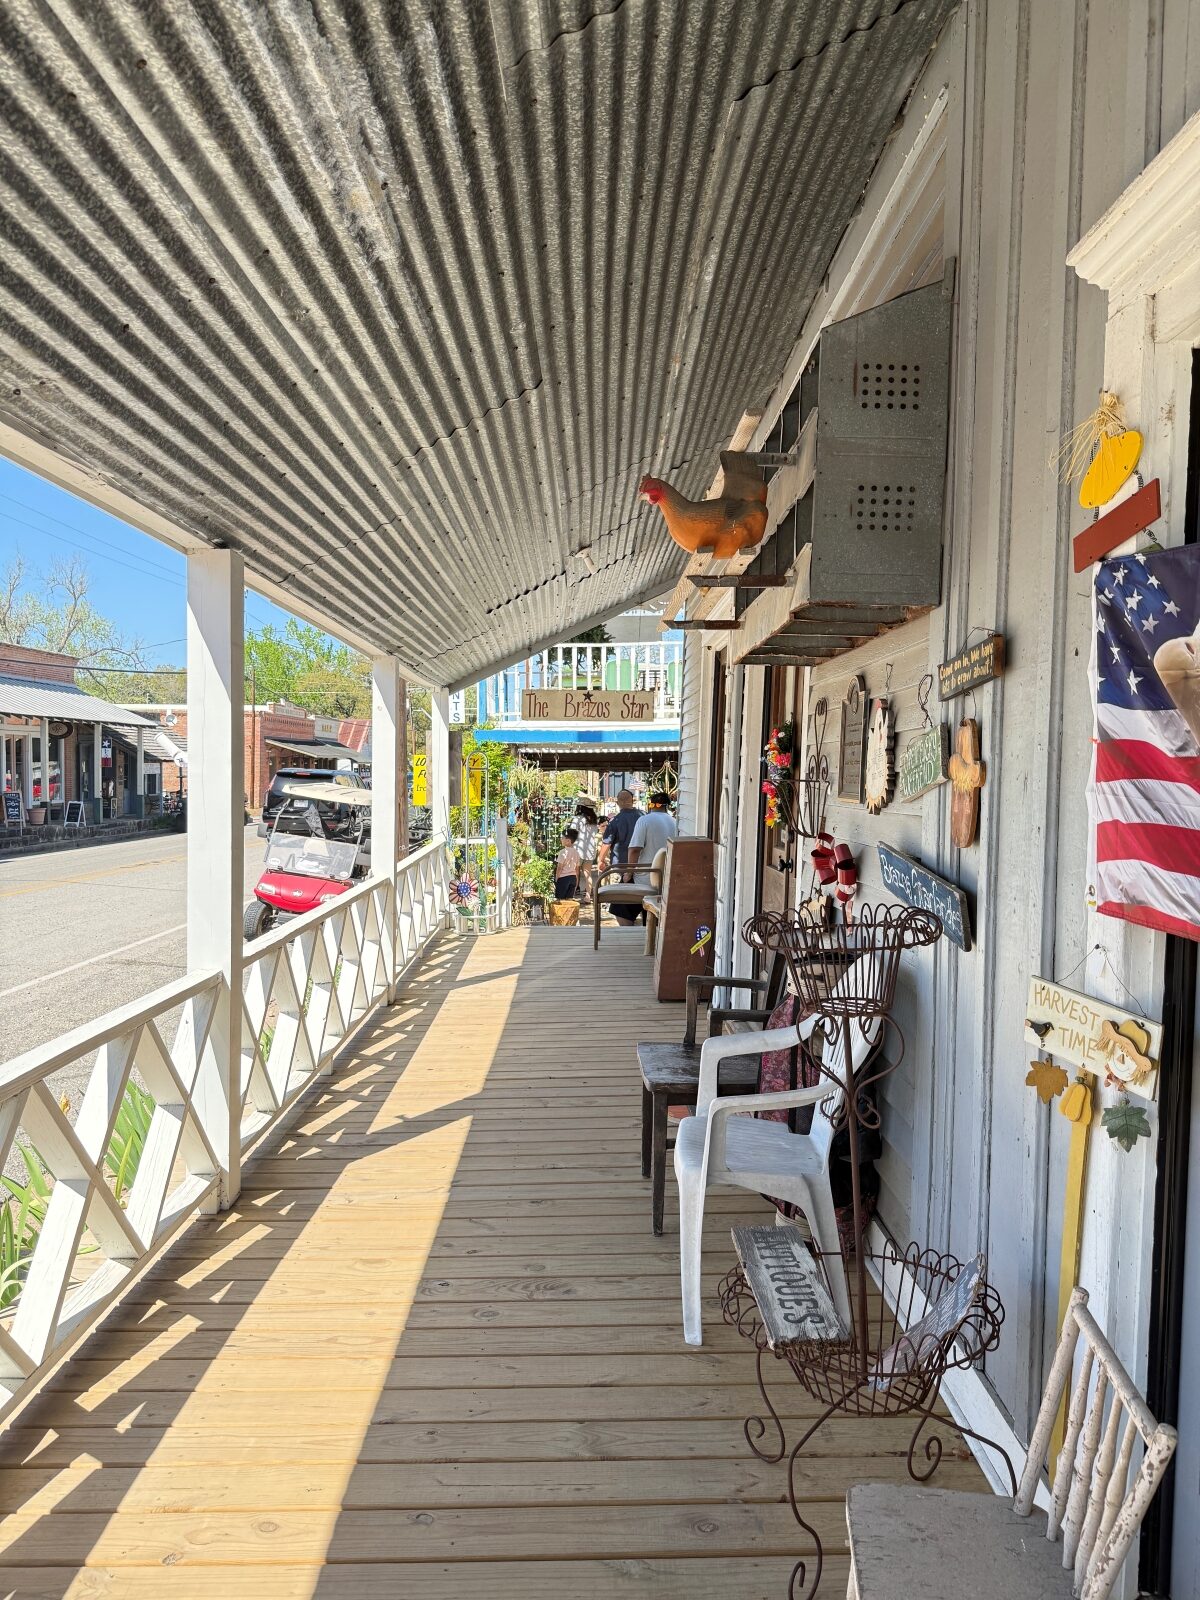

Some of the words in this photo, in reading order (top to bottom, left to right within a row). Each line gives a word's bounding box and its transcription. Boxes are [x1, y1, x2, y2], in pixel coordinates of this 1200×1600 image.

[525, 692, 549, 718] The
[564, 692, 610, 718] Brazos
[620, 693, 649, 719] Star
[880, 854, 912, 900] Brazos
[1034, 983, 1101, 1031] HARVEST
[1058, 1026, 1099, 1061] TIME
